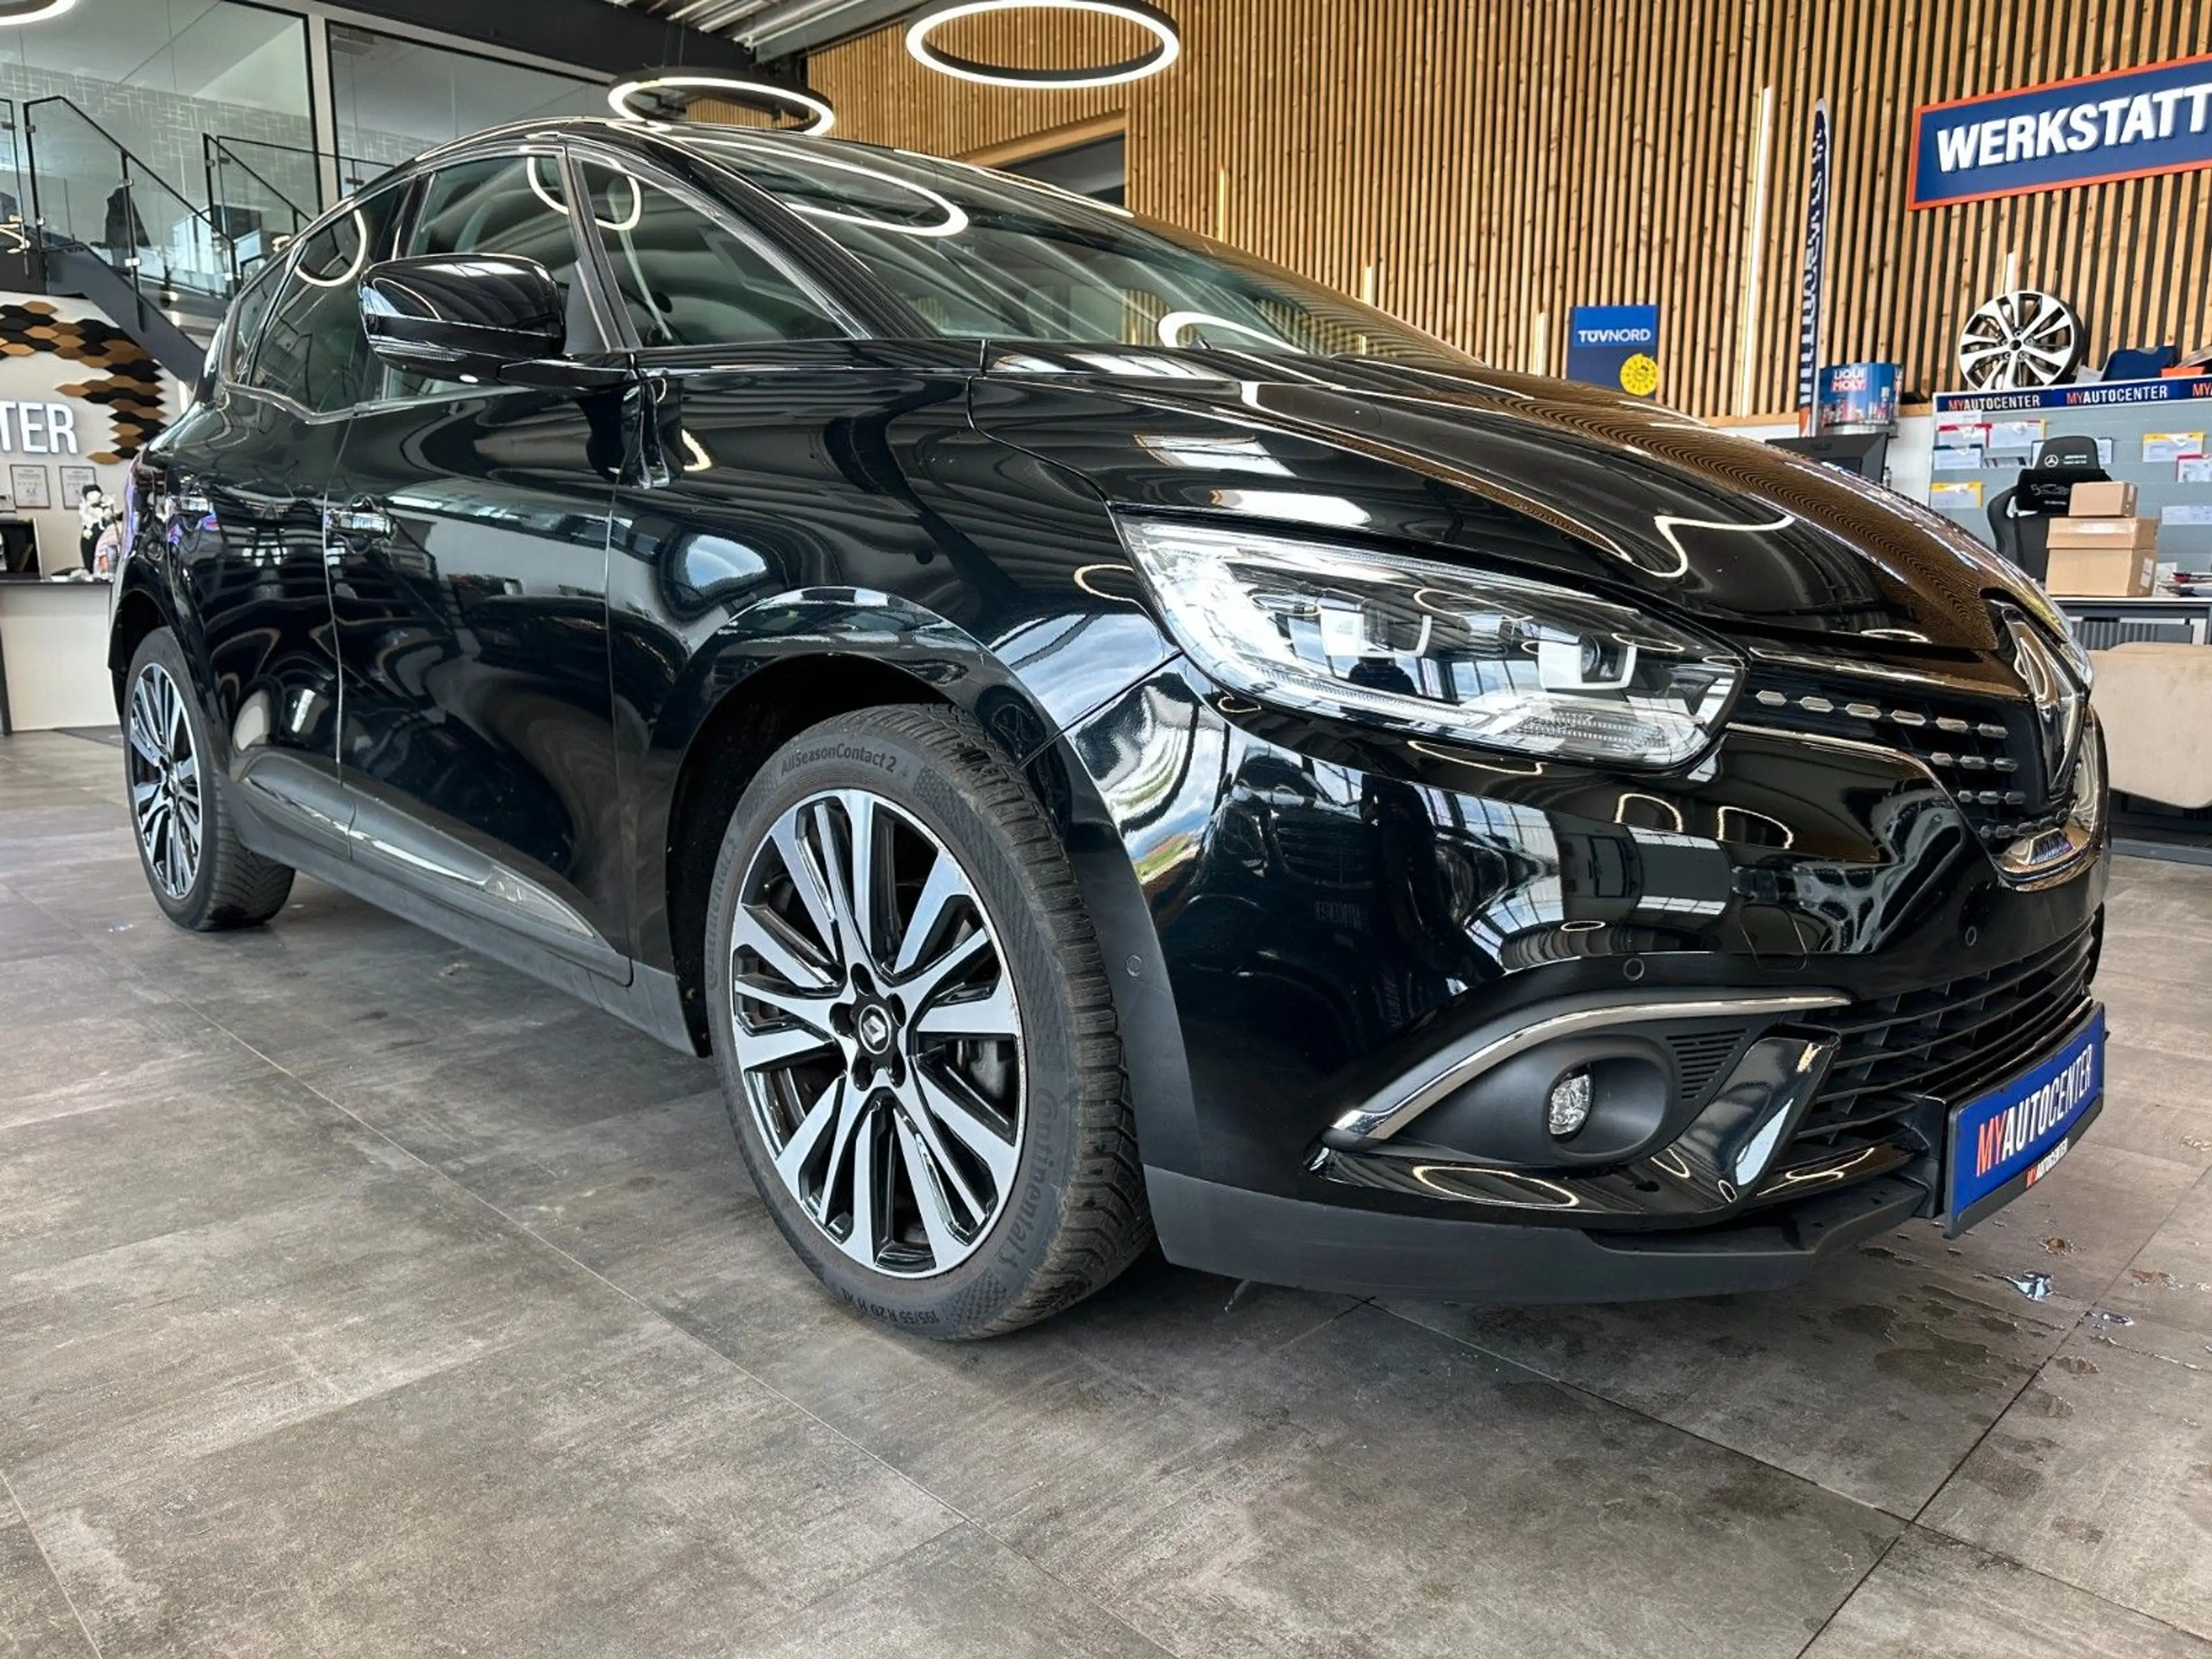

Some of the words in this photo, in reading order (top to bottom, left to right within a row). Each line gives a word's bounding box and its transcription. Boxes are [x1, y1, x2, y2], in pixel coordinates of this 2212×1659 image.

[1936, 82, 2212, 173] WERKSTATT
[1834, 365, 1865, 380] LIQUI
[1831, 379, 1867, 392] MOLY
[2066, 385, 2168, 406] MYAUTOCENTER
[1948, 395, 2040, 411] MYAUTOCENTER
[781, 743, 885, 777] AllSeasonContact
[885, 756, 897, 773] 2
[1976, 1043, 2093, 1177] MYAUTOCENTER
